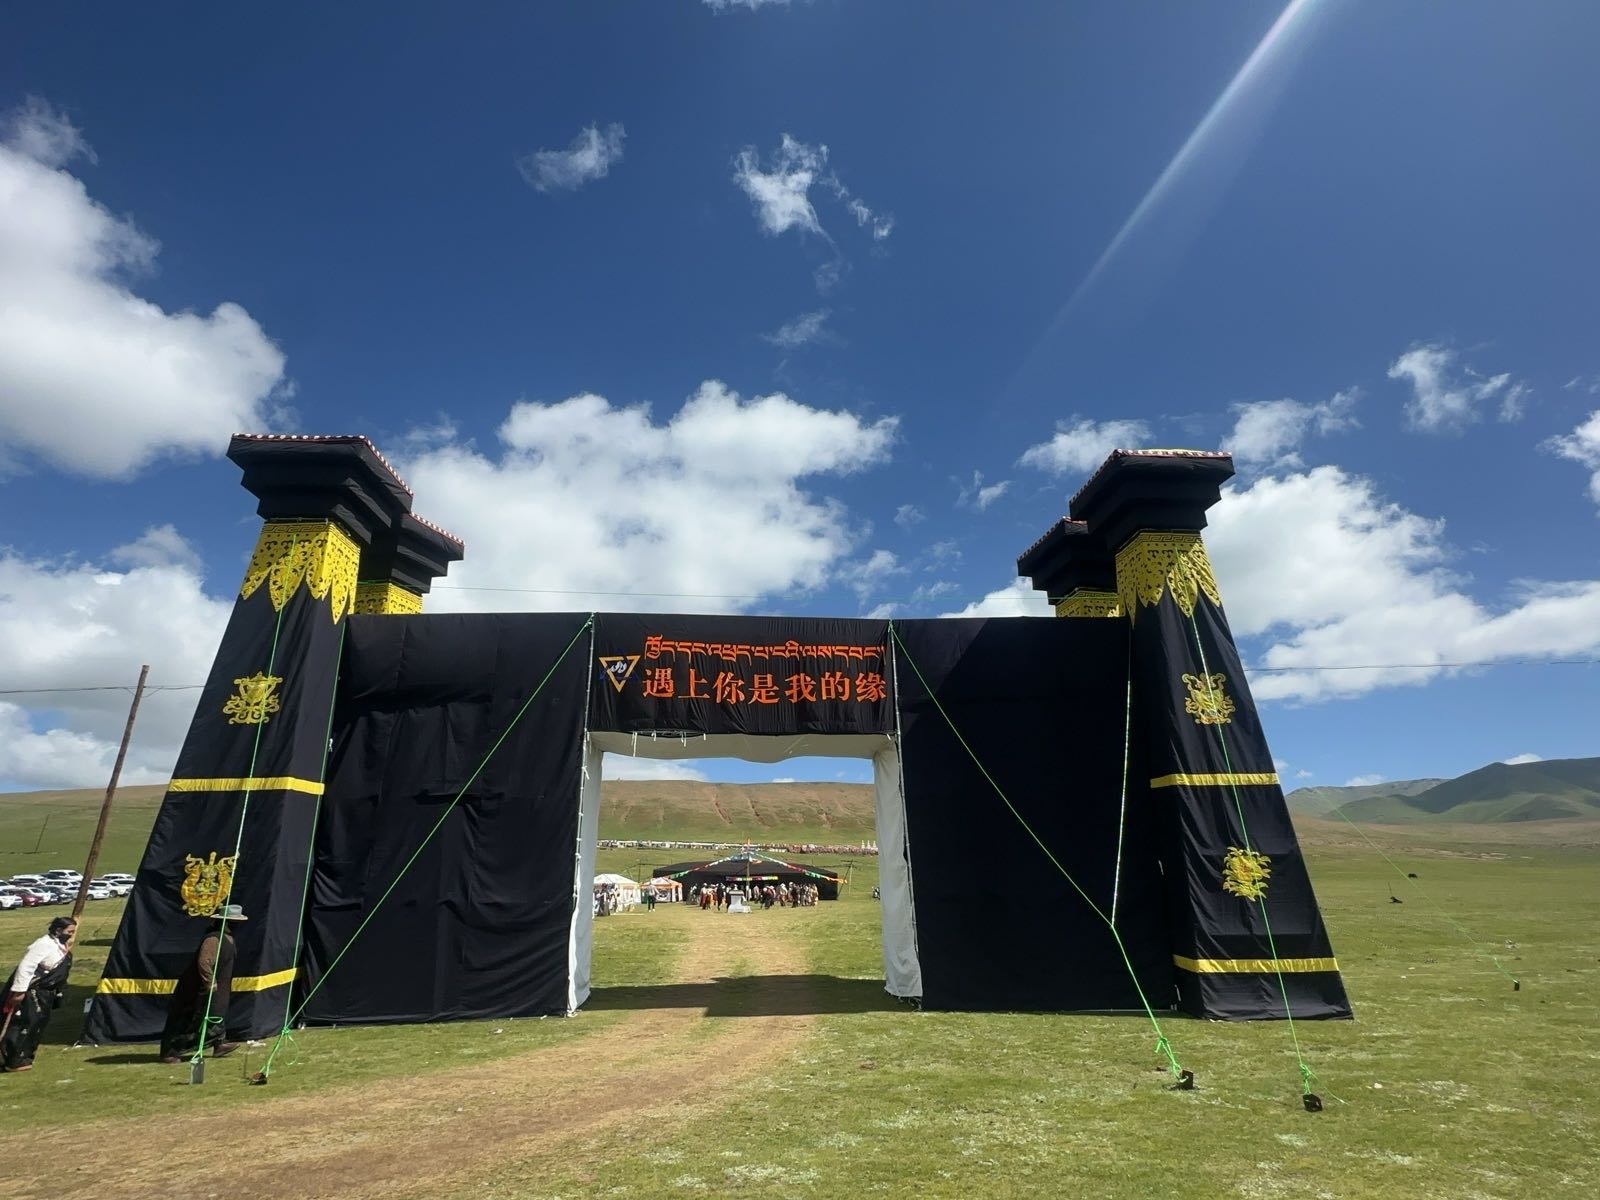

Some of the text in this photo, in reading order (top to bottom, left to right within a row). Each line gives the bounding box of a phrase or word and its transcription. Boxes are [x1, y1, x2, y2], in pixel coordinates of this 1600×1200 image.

[642, 667, 887, 705] 遇上你是我的缘
